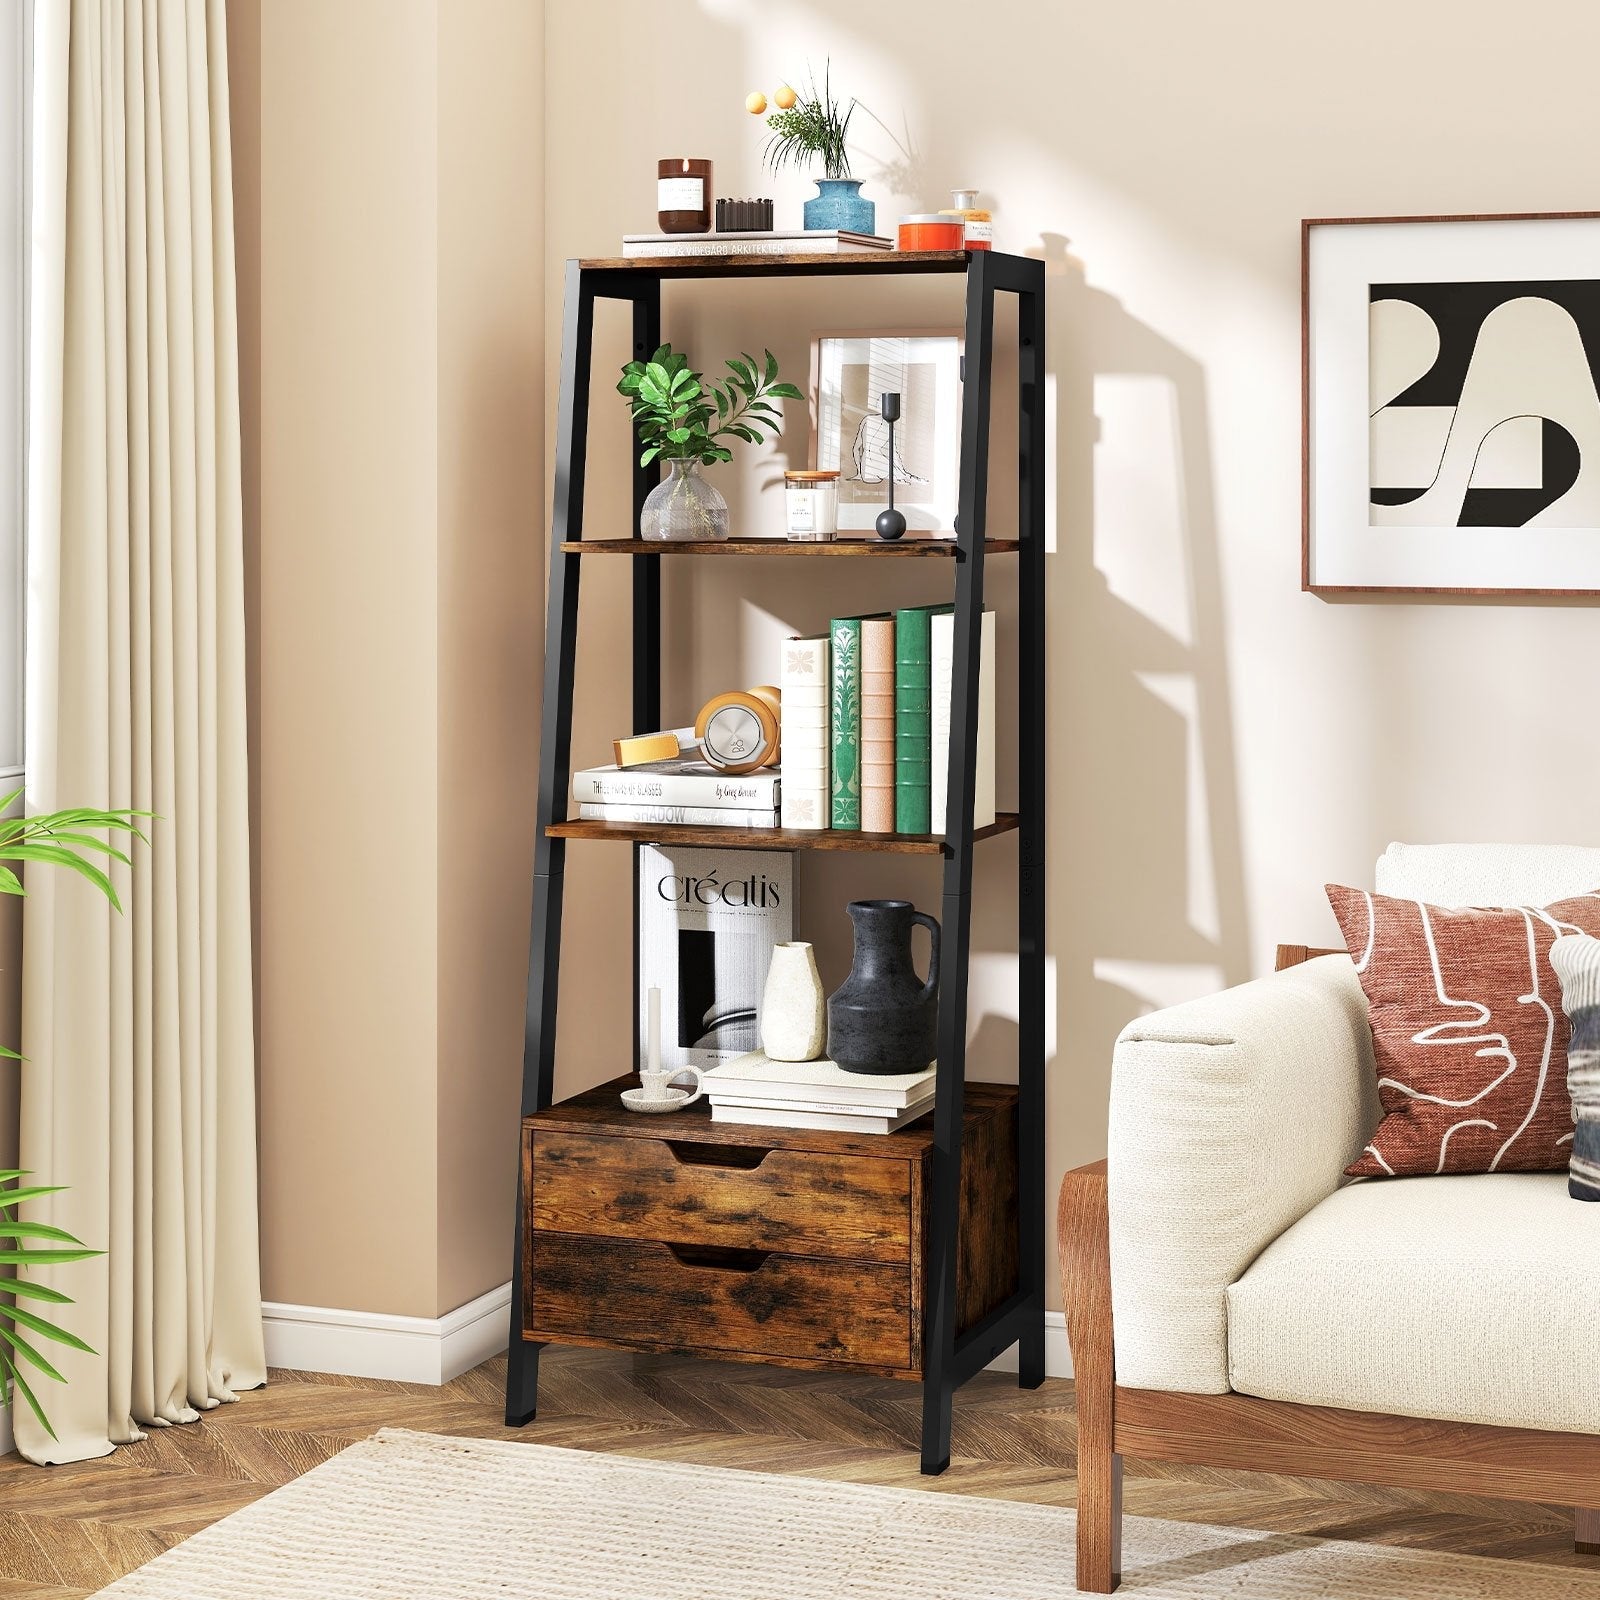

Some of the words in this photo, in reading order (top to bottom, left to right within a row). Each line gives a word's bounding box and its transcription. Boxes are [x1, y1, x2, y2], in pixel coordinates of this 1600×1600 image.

[731, 243, 784, 255] ARKITEKTER
[633, 806, 686, 824] SHADOW
[657, 868, 780, 908] créatis
